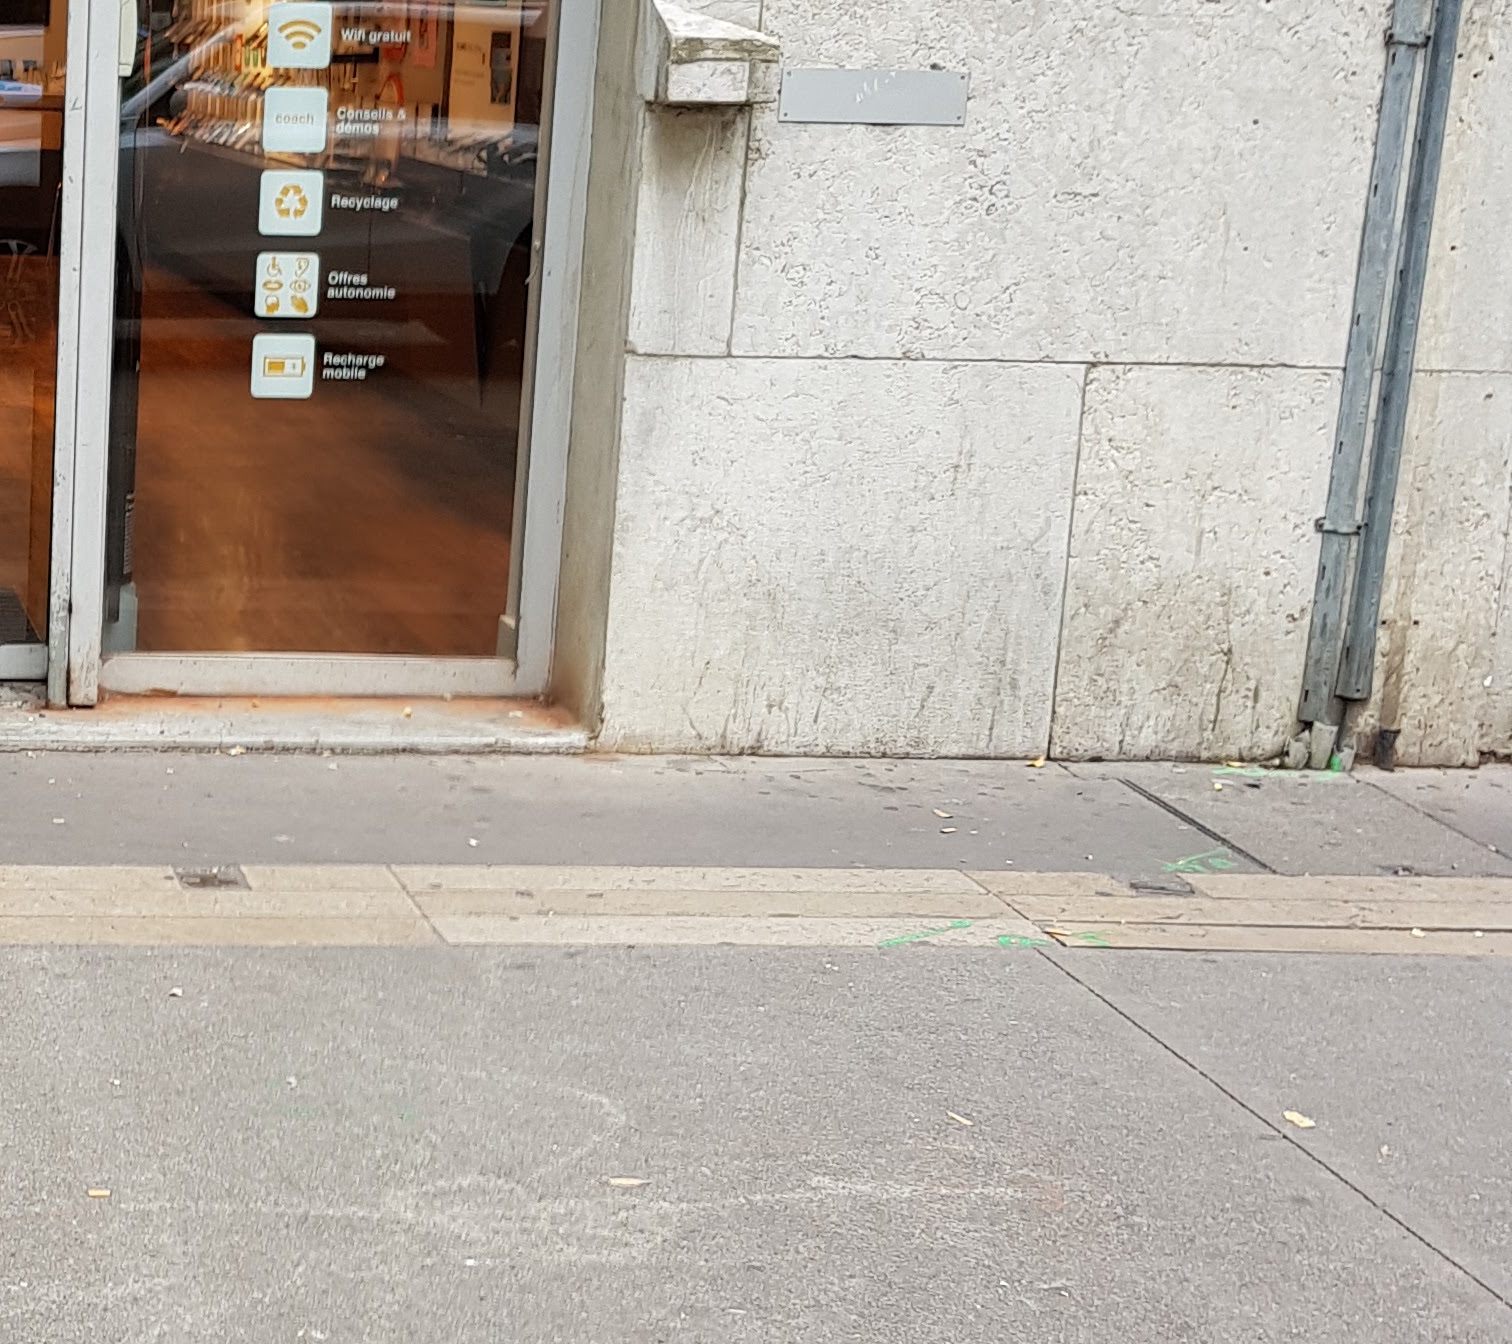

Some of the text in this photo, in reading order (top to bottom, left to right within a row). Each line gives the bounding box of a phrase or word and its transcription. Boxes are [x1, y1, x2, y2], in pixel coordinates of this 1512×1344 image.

[340, 27, 412, 44] Wifi gratuit
[336, 107, 393, 121] Conseils
[335, 120, 380, 134] démos
[331, 194, 399, 211] Recyclage
[327, 271, 368, 286] Offres
[326, 285, 396, 299] autonomie
[323, 352, 385, 369] Recharge
[322, 366, 366, 380] mobile
